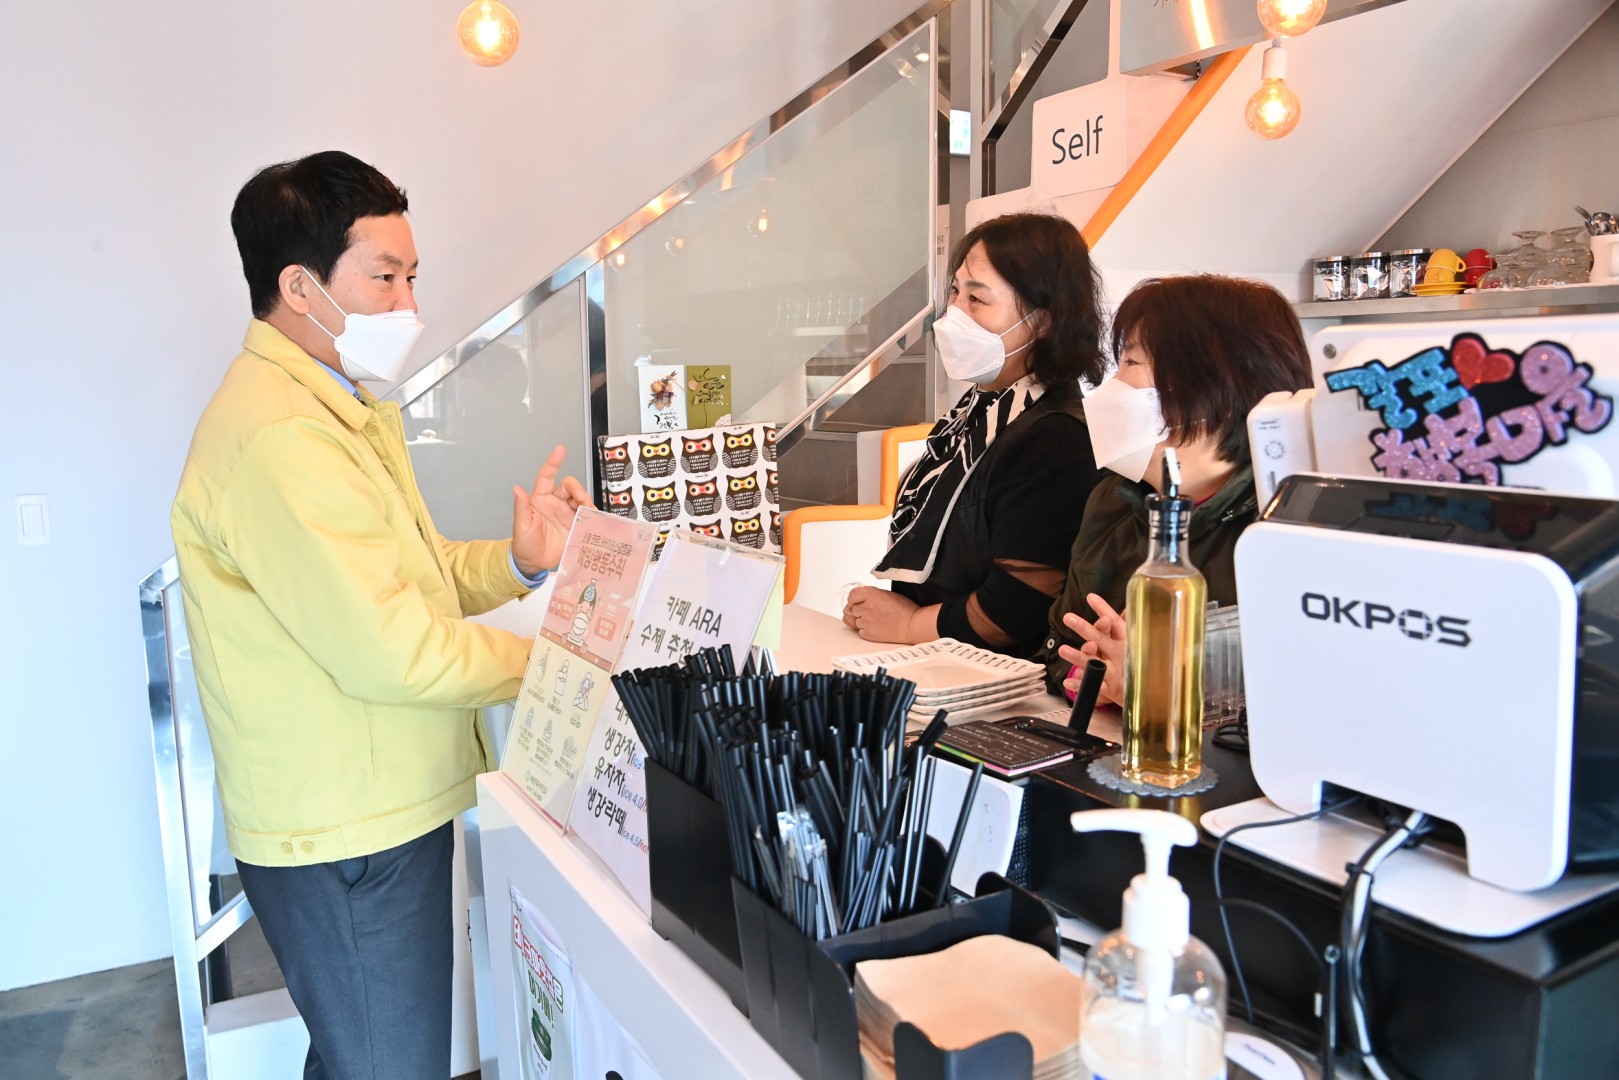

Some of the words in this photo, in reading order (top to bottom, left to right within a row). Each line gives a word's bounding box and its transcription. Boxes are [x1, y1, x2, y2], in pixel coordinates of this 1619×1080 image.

[1052, 114, 1103, 165] Self
[640, 623, 666, 654] 수제
[667, 595, 692, 626] 카페
[689, 606, 722, 638] ARA
[1301, 592, 1472, 648] OKPOS
